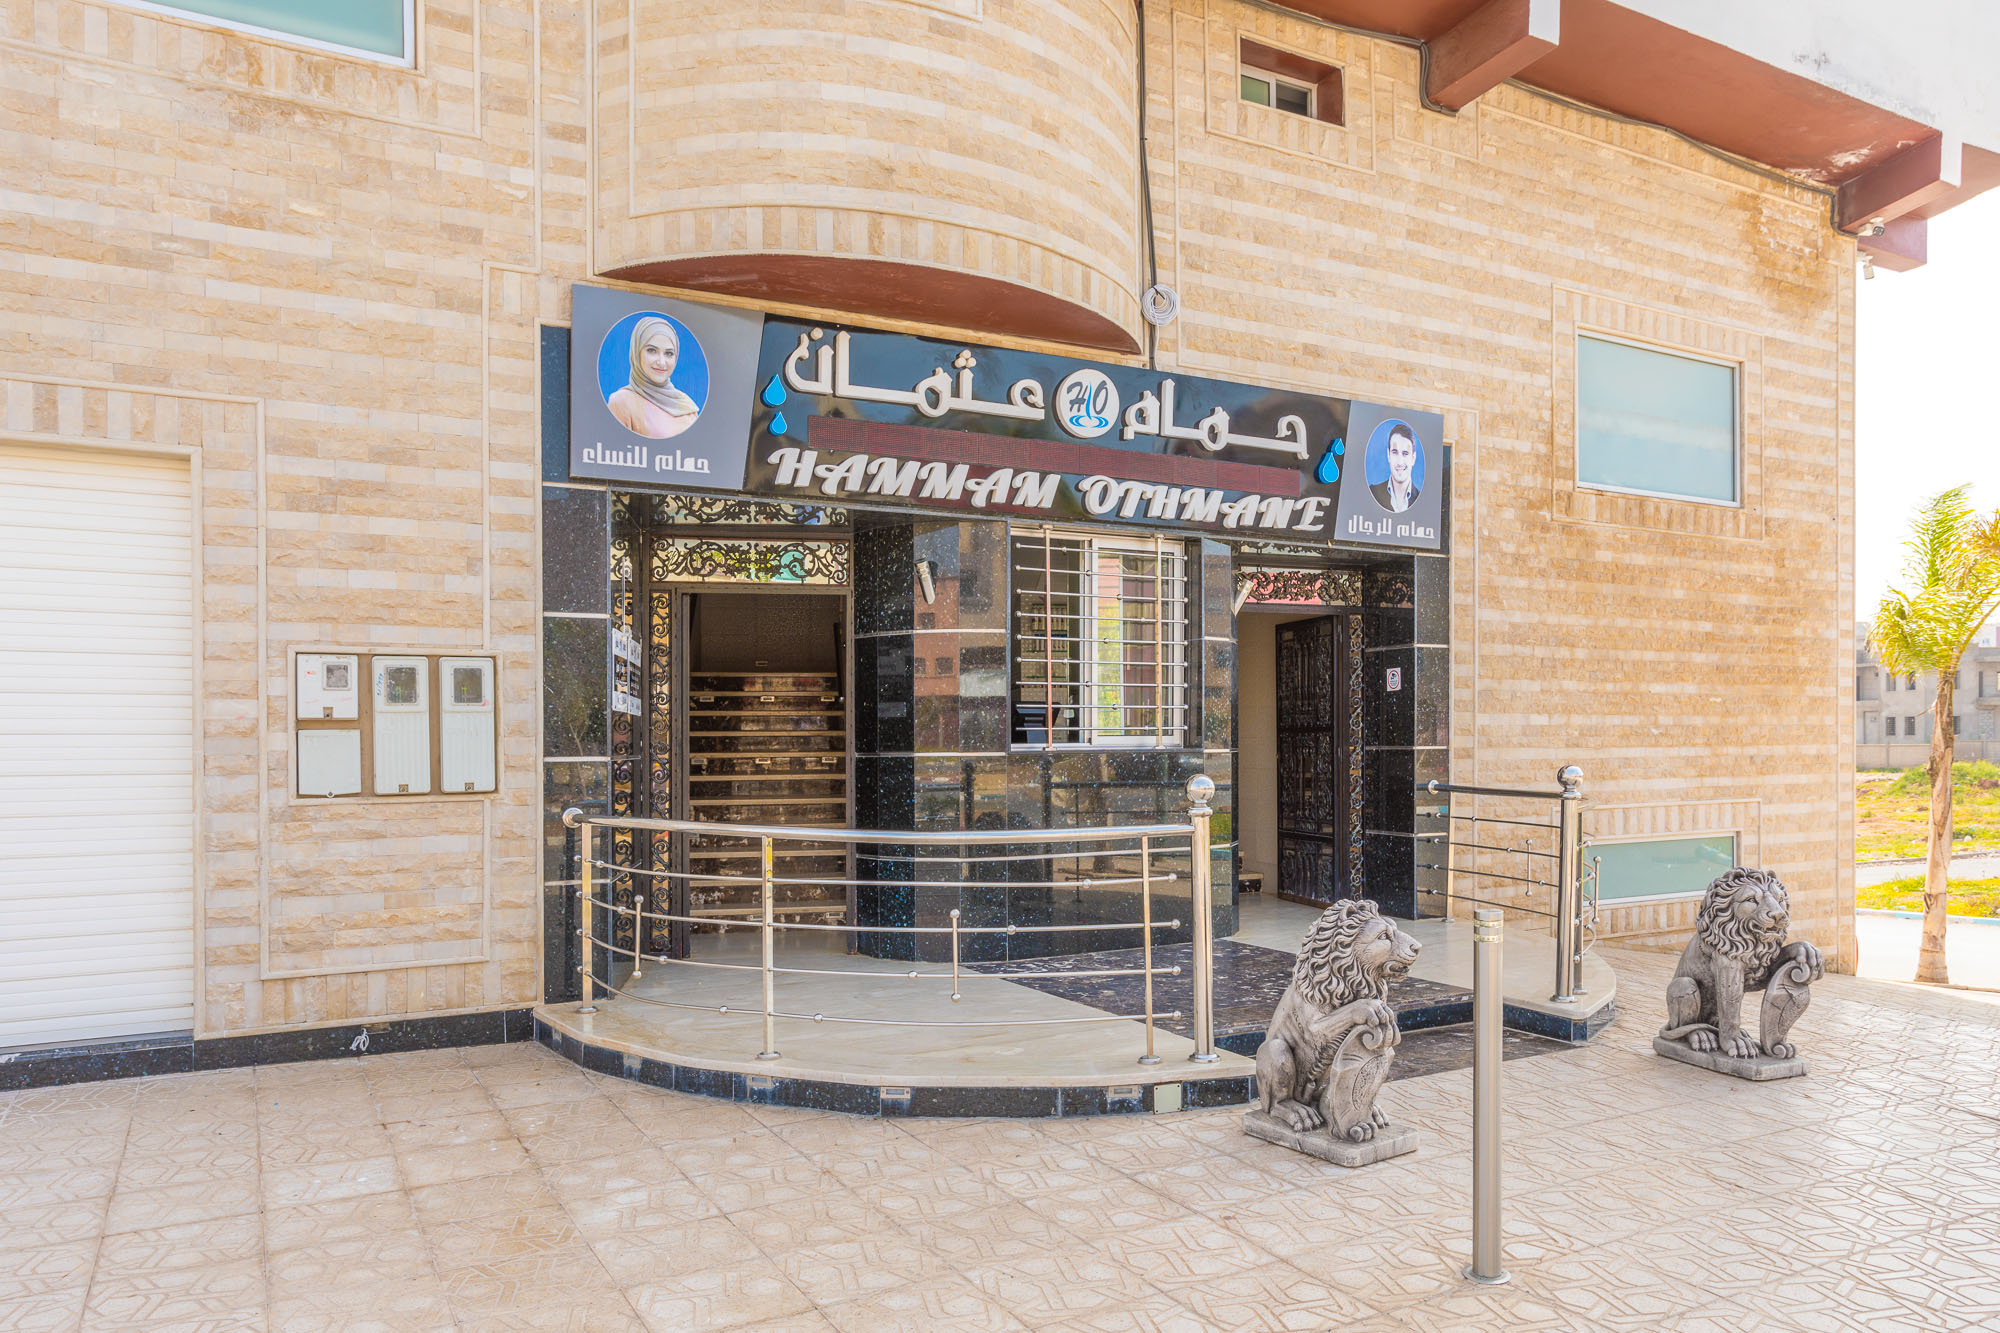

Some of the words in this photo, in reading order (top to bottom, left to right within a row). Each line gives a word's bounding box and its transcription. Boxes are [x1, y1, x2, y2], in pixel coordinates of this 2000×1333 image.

[785, 327, 1045, 420] عثمان
[1123, 378, 1310, 460] حمام
[582, 442, 648, 468] للنساء
[655, 449, 711, 474] حمام
[767, 447, 1061, 509] HAMMAM
[1078, 475, 1331, 532] OTHMANE
[1348, 514, 1392, 537] للرجال
[1397, 520, 1435, 539] حمام
